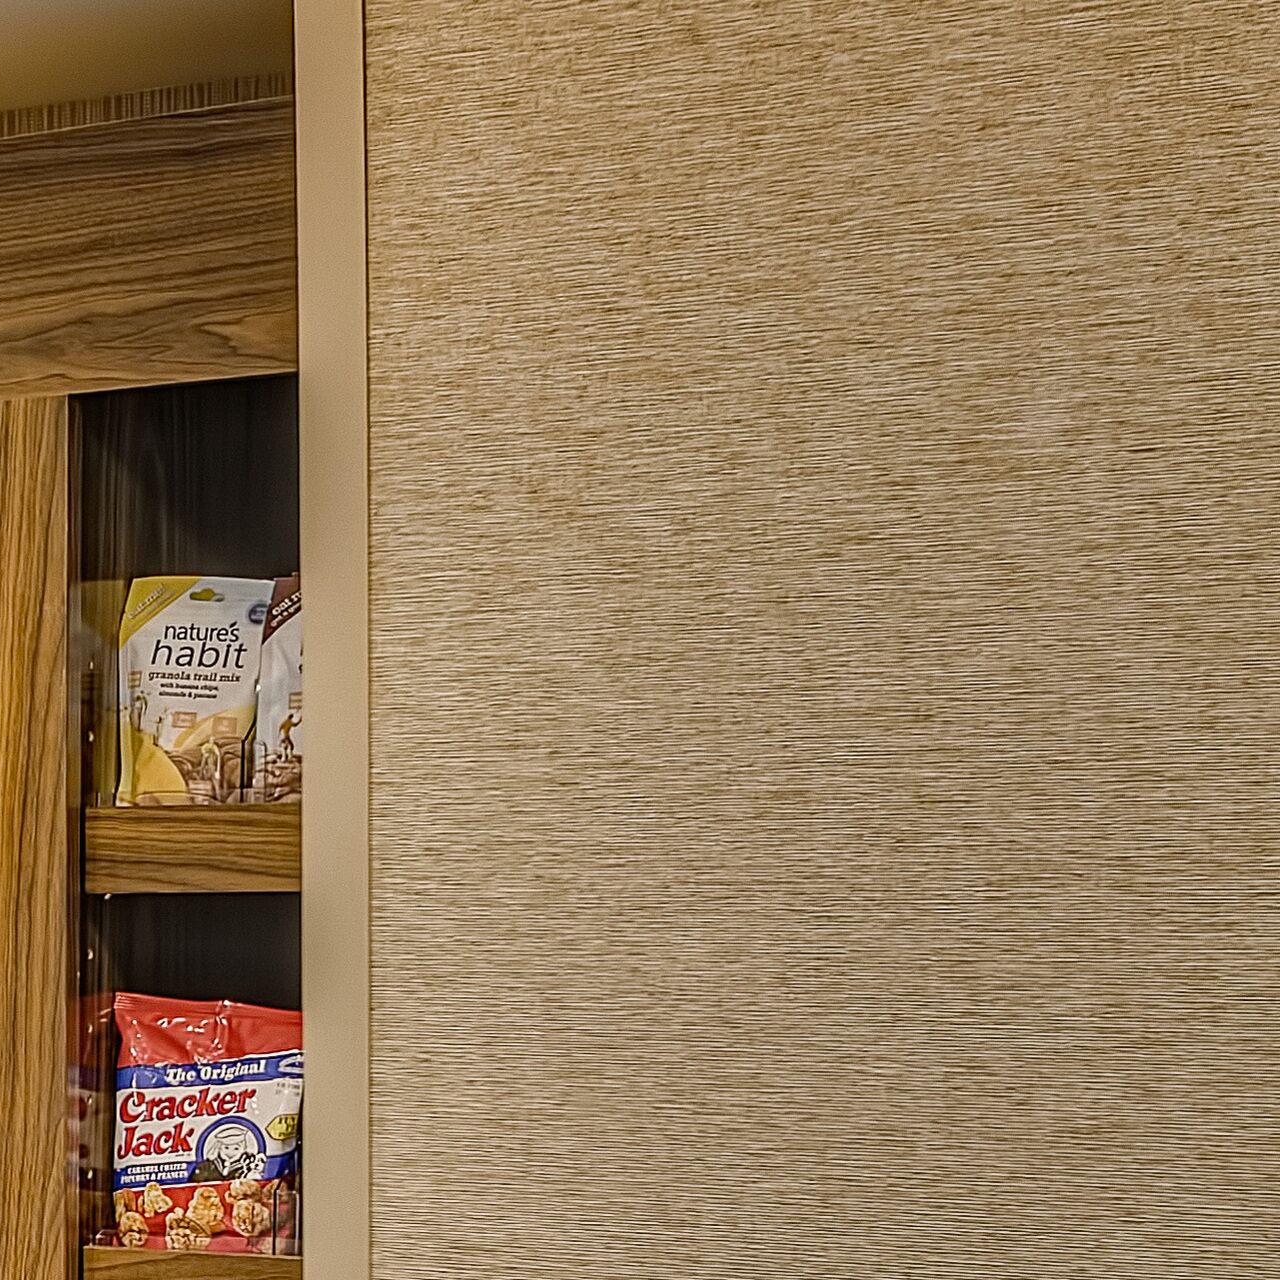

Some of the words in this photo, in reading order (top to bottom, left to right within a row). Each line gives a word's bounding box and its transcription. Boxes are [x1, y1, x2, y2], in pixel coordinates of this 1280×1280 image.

[164, 622, 240, 642] nature's
[151, 640, 247, 669] habit
[148, 671, 191, 682] granola
[194, 672, 218, 682] trail
[219, 672, 241, 682] mix
[166, 1067, 196, 1083] The
[200, 1060, 266, 1081] Original
[119, 1087, 257, 1124] Cracker
[117, 1121, 195, 1160] Jack
